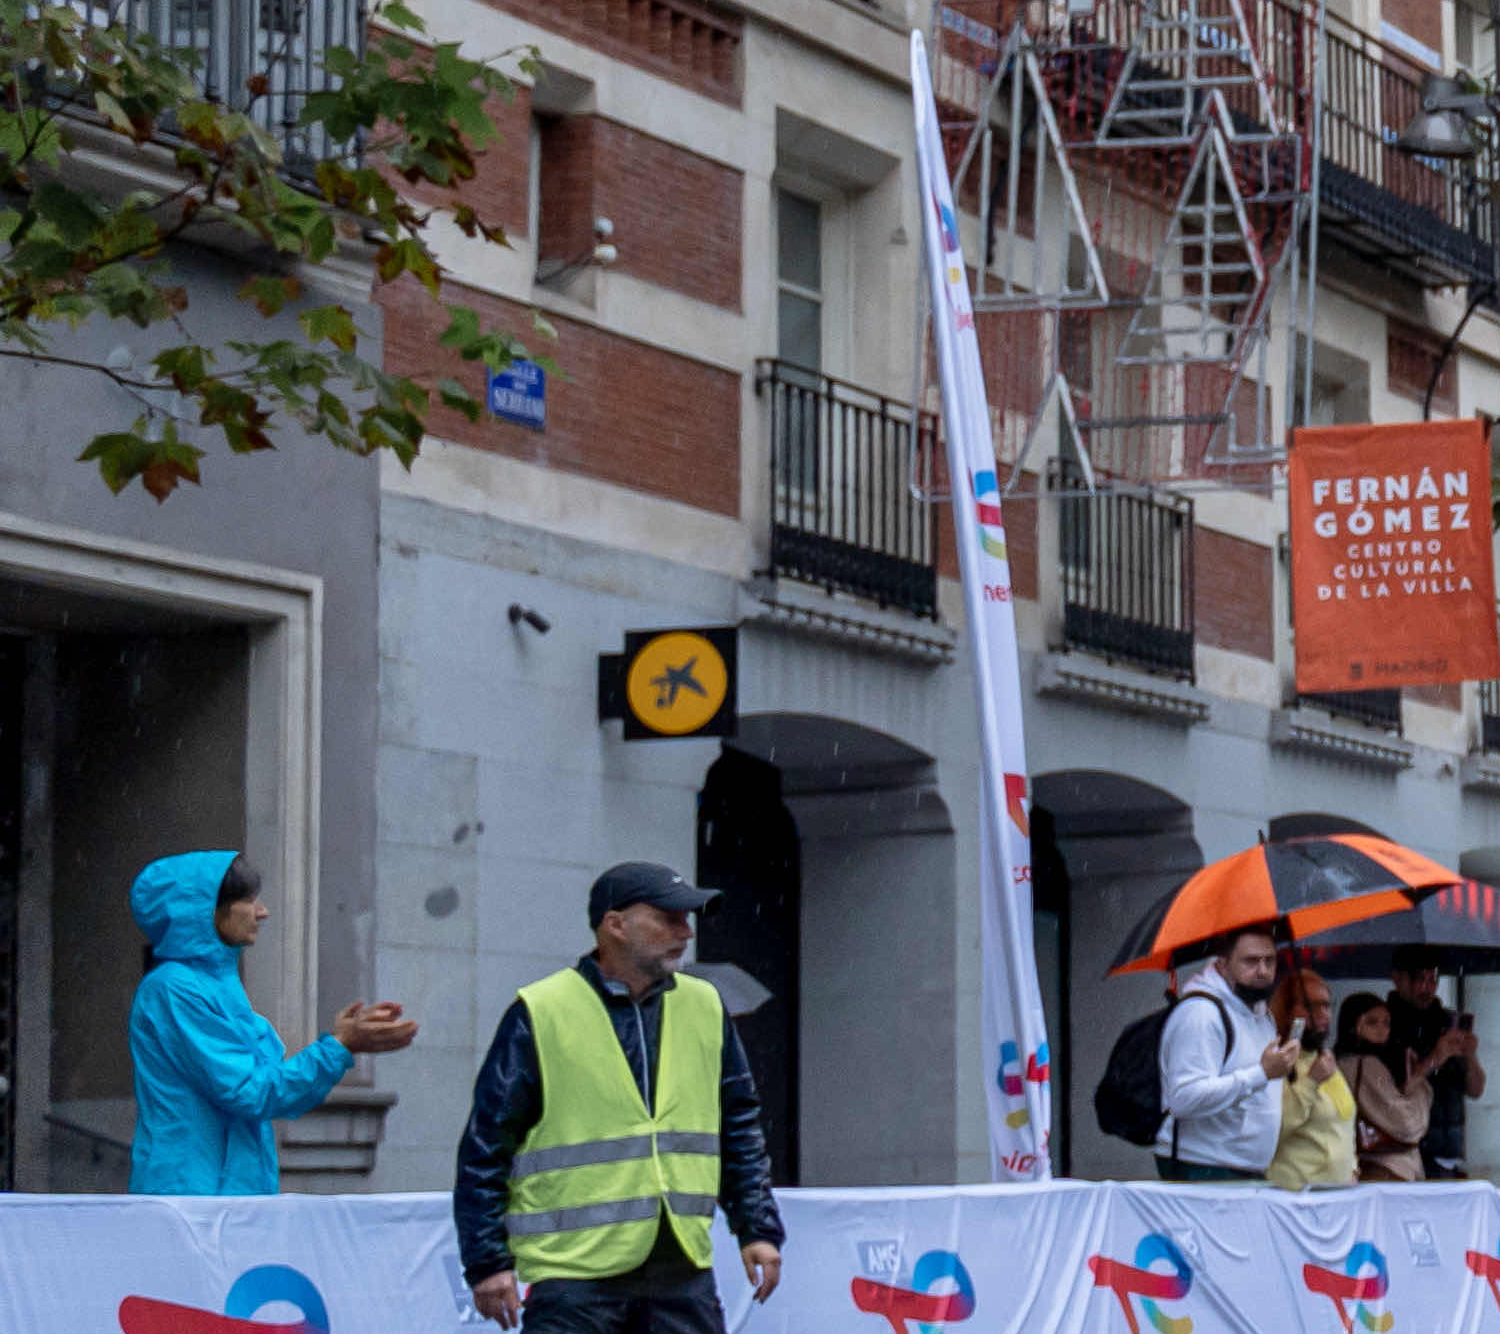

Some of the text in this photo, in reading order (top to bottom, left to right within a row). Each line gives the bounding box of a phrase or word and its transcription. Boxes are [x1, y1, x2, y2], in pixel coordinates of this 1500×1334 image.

[1312, 467, 1469, 506] FERNÁN
[1314, 502, 1470, 538] GÓMEZ
[1347, 538, 1442, 559] CENTRO
[1333, 558, 1455, 580] CULTURAL
[1317, 576, 1473, 601] DE LA VILLA
